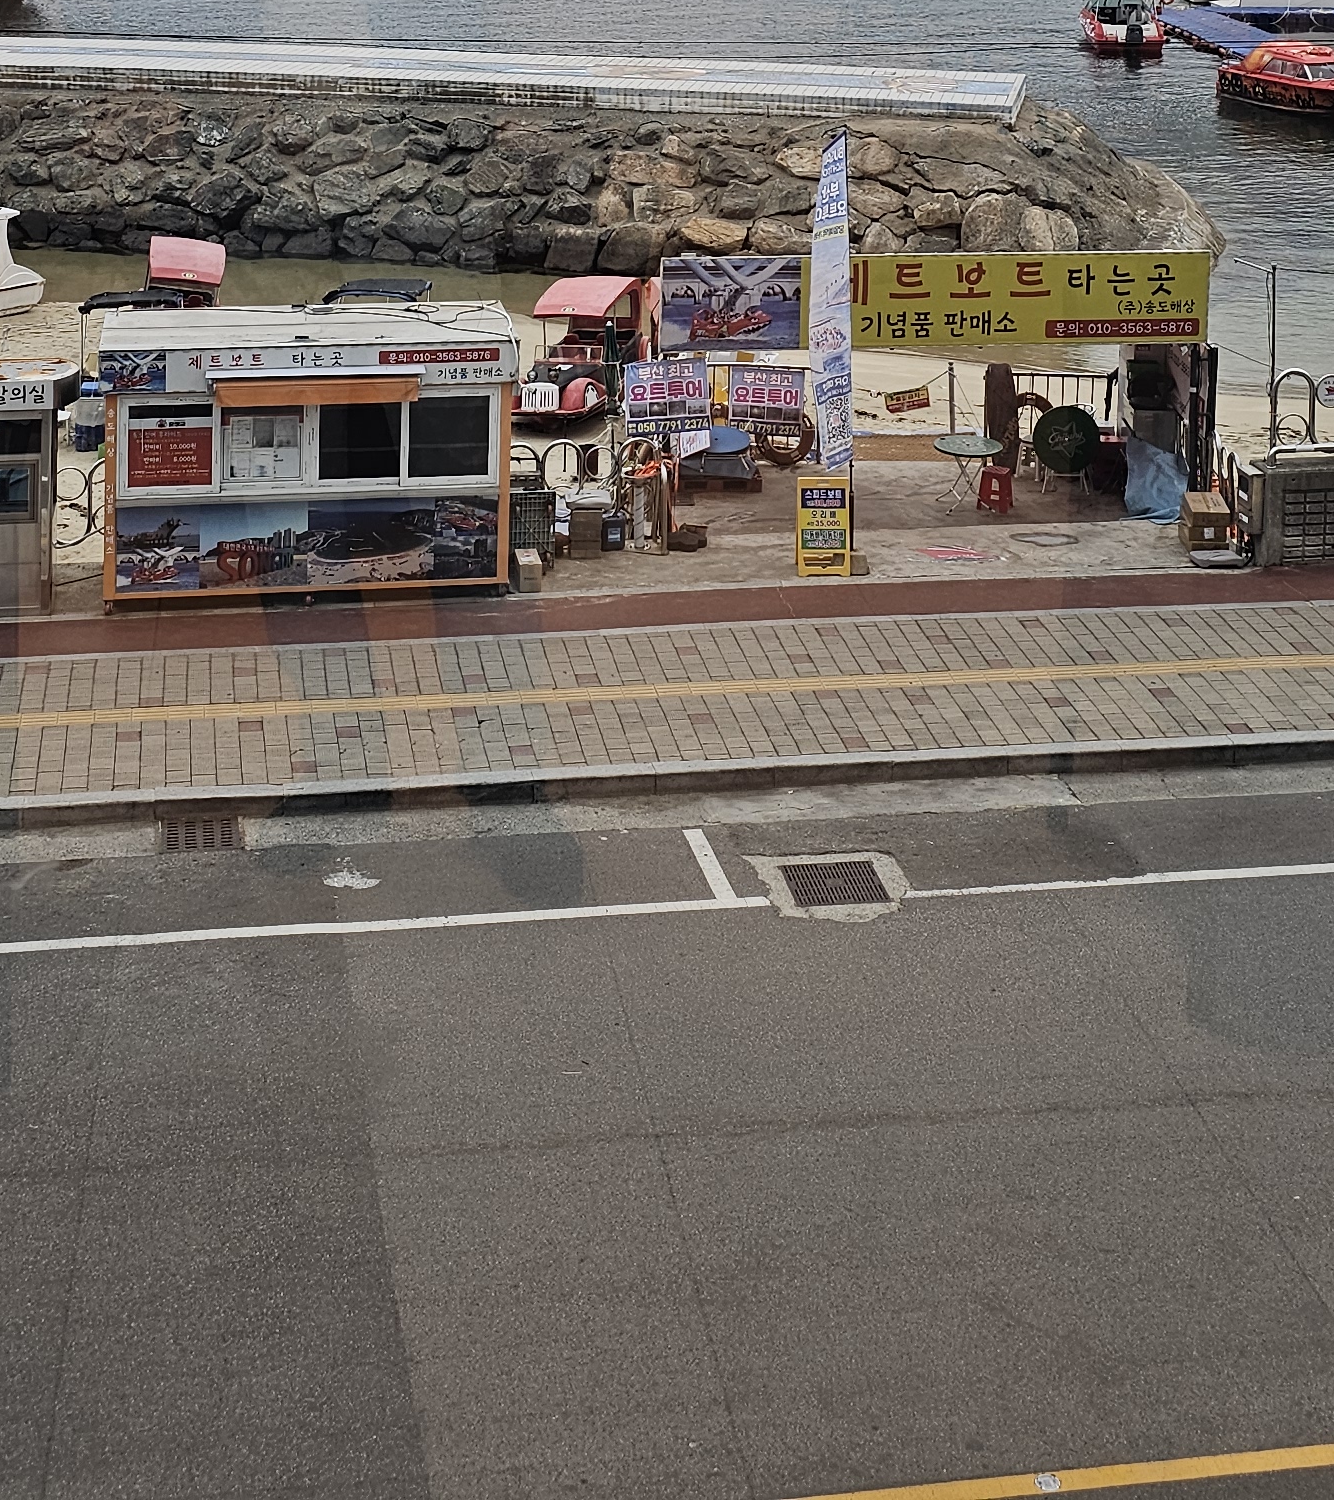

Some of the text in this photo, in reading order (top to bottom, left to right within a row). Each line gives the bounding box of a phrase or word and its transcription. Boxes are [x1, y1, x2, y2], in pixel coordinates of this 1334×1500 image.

[1067, 263, 1176, 297] 타는곳
[1117, 299, 1196, 315] (주)송도해상
[860, 309, 1018, 340] 기념품 판매소
[1054, 320, 1193, 337] 문의: 010-3563-5876
[188, 351, 344, 370] 제트보트 타는곳
[388, 350, 491, 363] 문의: 010-3563-5876
[437, 365, 504, 380] 기념품 판매소
[638, 363, 694, 380] 부산 최고
[743, 371, 793, 386] 부산 최고
[630, 378, 703, 402] 요트투어
[733, 385, 800, 407] 요트투어
[106, 408, 116, 457] 송도해상
[637, 416, 709, 432] 050 7791 2374
[756, 422, 776, 434] 7791
[779, 425, 800, 436] 2374
[804, 489, 842, 498] 스피드보트
